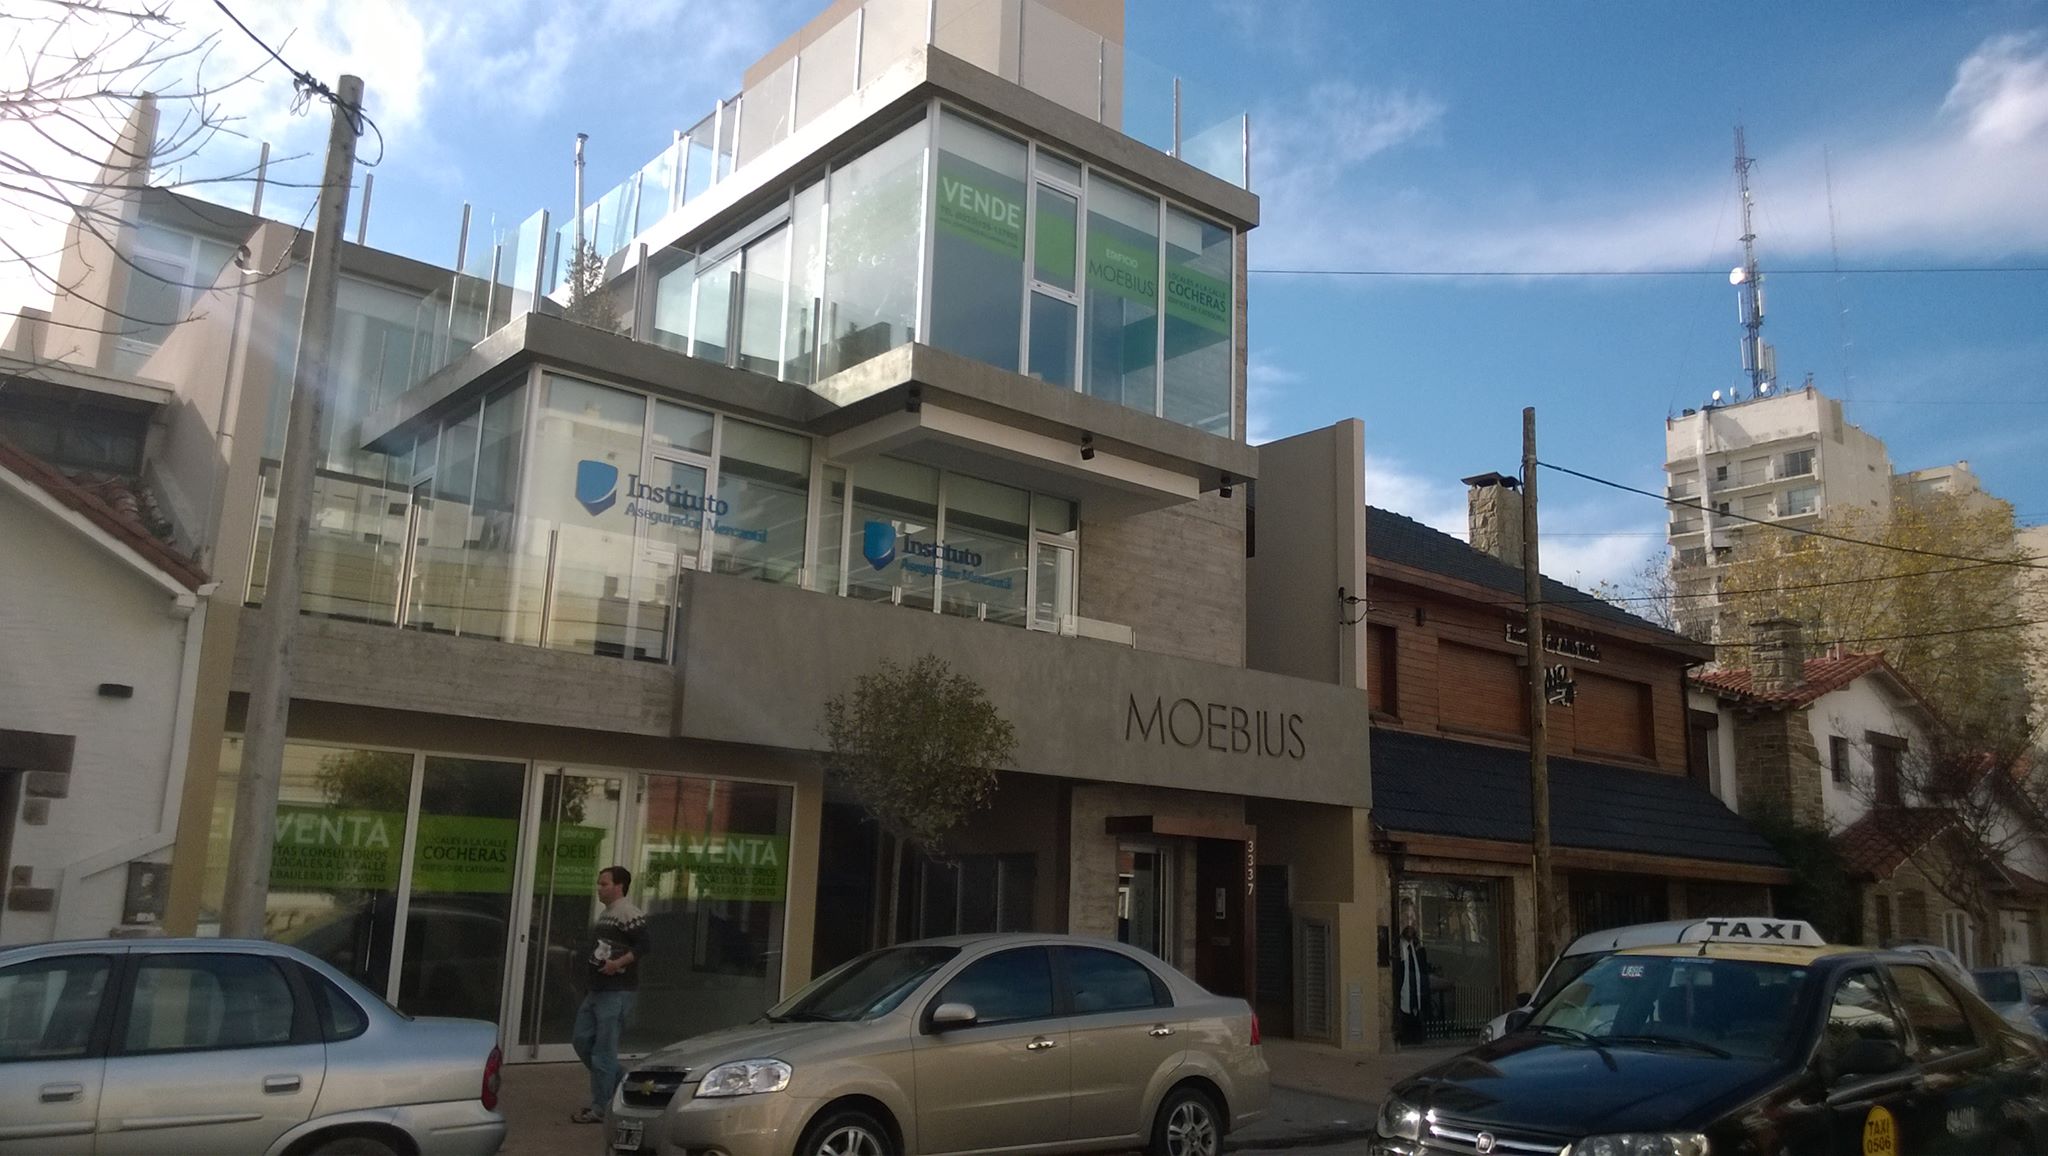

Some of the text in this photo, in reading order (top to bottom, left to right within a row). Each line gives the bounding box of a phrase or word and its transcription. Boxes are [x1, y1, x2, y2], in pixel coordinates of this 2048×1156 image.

[942, 176, 1021, 229] VENDE
[1088, 258, 1154, 297] MOEBIUS
[1168, 280, 1226, 313] COCHERAS
[627, 473, 728, 516] Instituto
[902, 532, 982, 568] Instituto
[1125, 693, 1306, 761] MOEBIUS
[275, 812, 390, 848] VENTA
[423, 846, 507, 863] COCHERAS
[688, 835, 779, 867] VENTA
[1247, 841, 1255, 896] 3337
[1706, 921, 1802, 940] TAXI
[1868, 1117, 1889, 1137] TAXI
